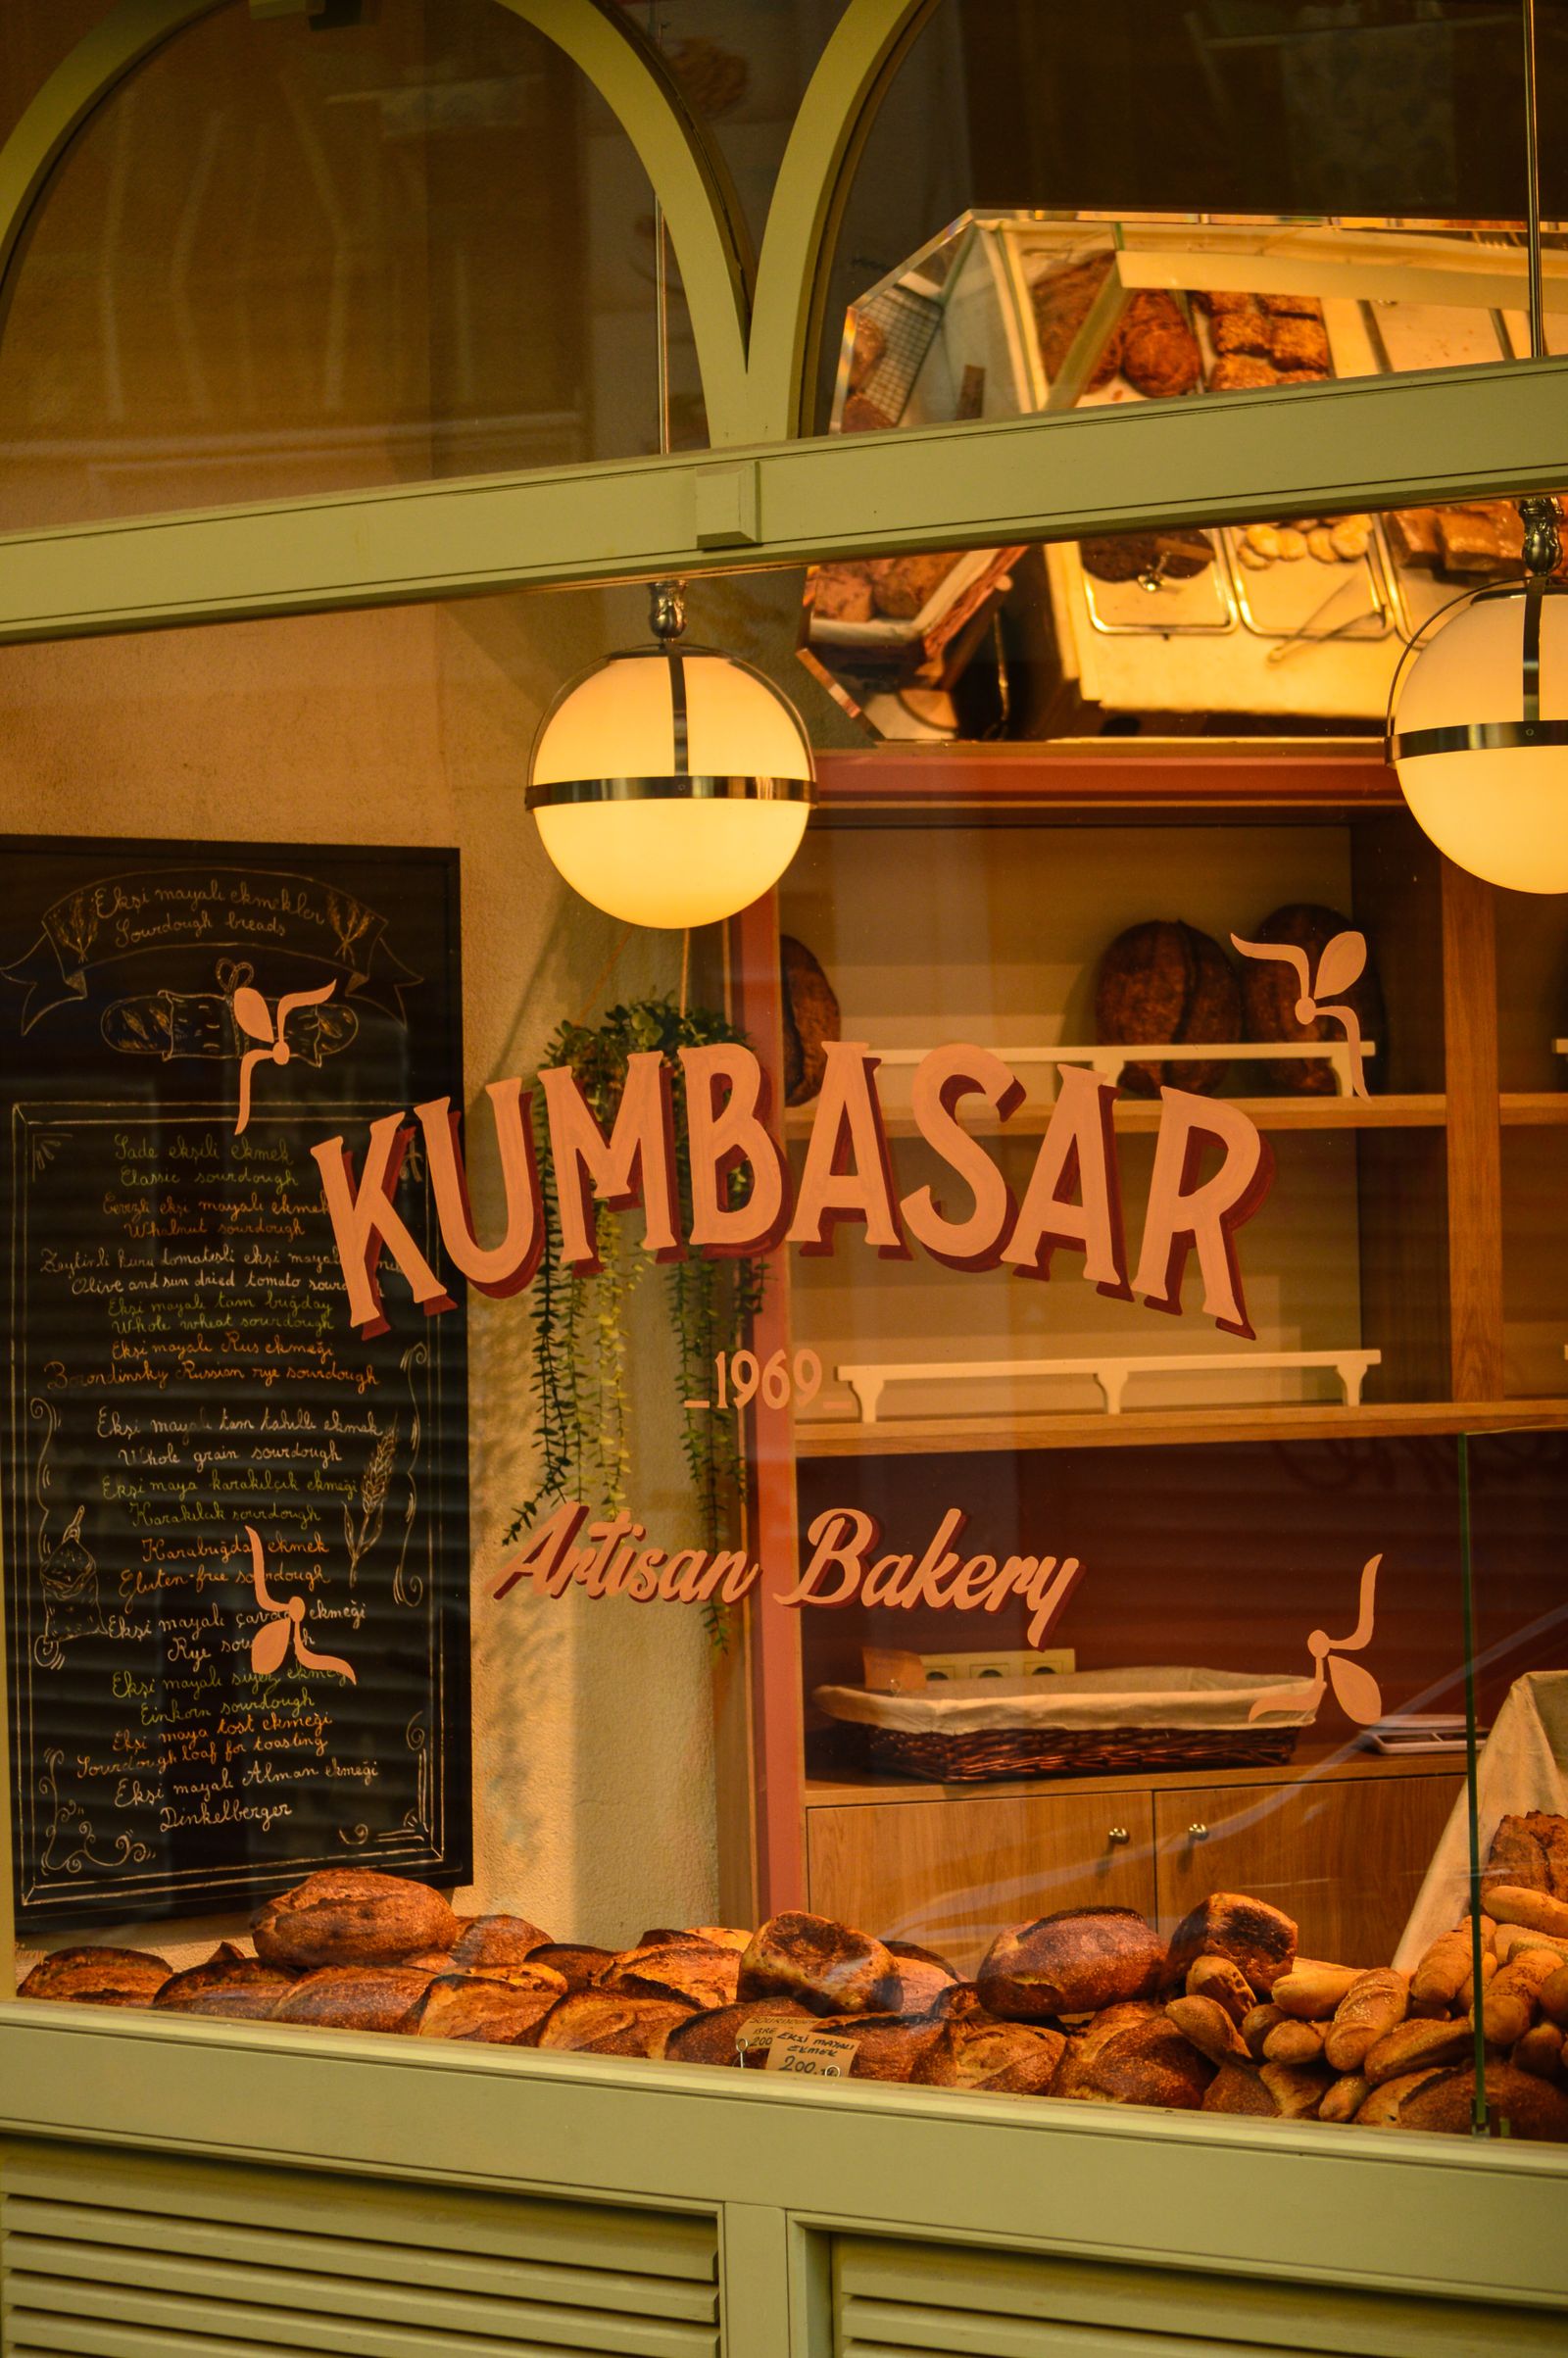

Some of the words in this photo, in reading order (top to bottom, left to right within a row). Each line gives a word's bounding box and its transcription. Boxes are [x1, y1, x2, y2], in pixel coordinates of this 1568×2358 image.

[154, 878, 225, 912] mayalı
[115, 909, 214, 948] Sourdough
[224, 909, 286, 937] breads
[231, 1135, 295, 1166] ekmek
[192, 1166, 300, 1195] sourdough
[310, 1041, 1276, 1341] KUMBASAR
[198, 1192, 265, 1222] mayalı
[217, 1217, 307, 1243] sourdough
[288, 1245, 341, 1274] mayal
[72, 1275, 124, 1296] Olive
[128, 1270, 160, 1292] and
[163, 1275, 190, 1289] sun
[193, 1267, 236, 1289] dried
[244, 1269, 302, 1288] tomato
[215, 1290, 256, 1311] tam
[111, 1317, 172, 1336] Whole
[179, 1312, 235, 1332] wheat
[239, 1309, 335, 1338] sourdough
[151, 1332, 214, 1360] mayalı
[220, 1331, 261, 1354] Rus
[174, 1358, 246, 1383] Russian
[251, 1366, 281, 1388] rye
[285, 1359, 380, 1393] sourdough
[218, 1406, 256, 1432] tam
[322, 1408, 383, 1437] ekmek
[117, 1442, 181, 1467] Whole
[192, 1445, 240, 1474] grain
[250, 1438, 343, 1472] sourdough
[148, 1479, 199, 1502] maya
[231, 1500, 322, 1531] sourdough
[141, 1532, 254, 1564] Karabuğda
[267, 1531, 331, 1554] ekmek
[492, 1501, 763, 1604] Artisan
[771, 1507, 1088, 1652] Bakery
[158, 1601, 226, 1640] mayalı
[234, 1609, 292, 1629] çavda
[166, 1636, 213, 1672] Rye
[162, 1664, 222, 1699] mayalı
[220, 1687, 316, 1718] sourdough
[158, 1728, 210, 1750] maya
[216, 1713, 255, 1736] tost
[75, 1750, 177, 1780] Sourdough
[181, 1742, 219, 1767] loaf
[223, 1741, 247, 1763] for
[252, 1733, 329, 1758] toasting
[172, 1767, 235, 1802] mayalı
[241, 1758, 319, 1787] Alman
[158, 1797, 294, 1834] Dinkelberger
[786, 2043, 839, 2058] EKMEK
